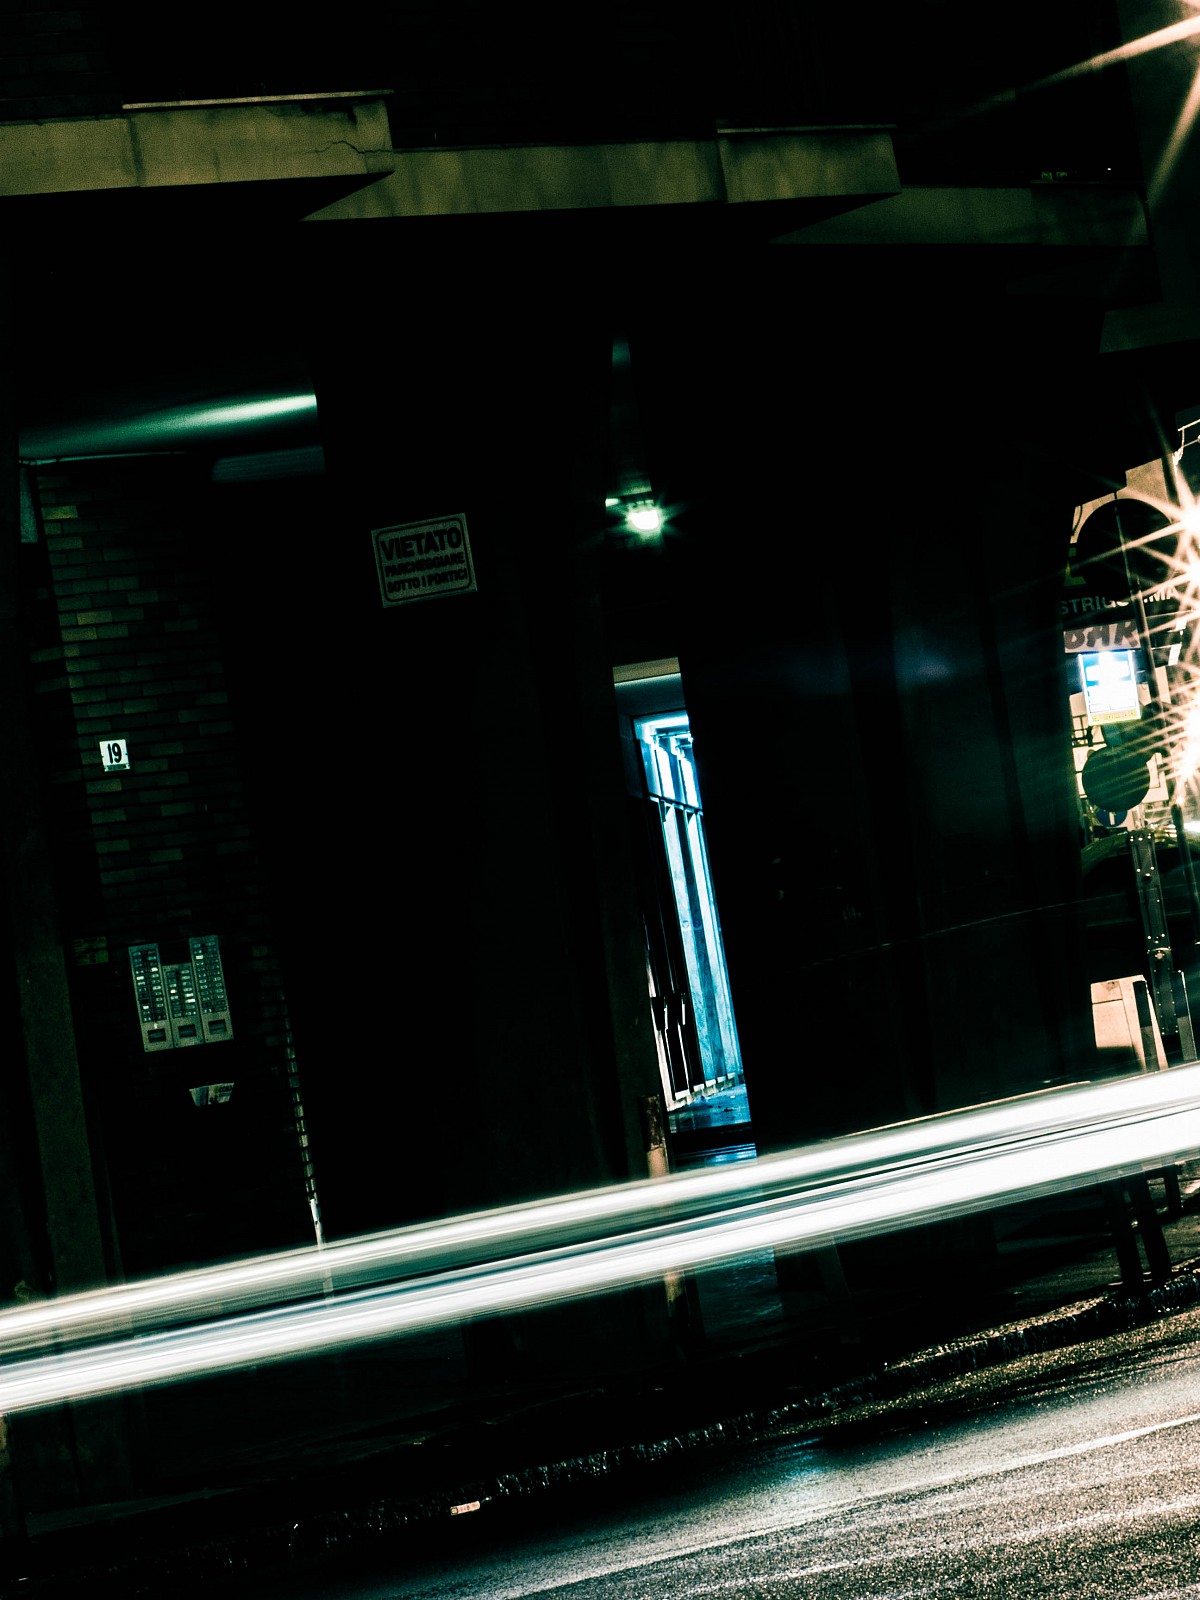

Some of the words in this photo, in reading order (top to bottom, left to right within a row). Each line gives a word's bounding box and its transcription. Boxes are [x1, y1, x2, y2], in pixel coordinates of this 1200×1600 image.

[380, 527, 462, 561] VIETATO
[385, 552, 465, 577] PARCHEGGIARE
[386, 577, 420, 593] SOTTO
[427, 568, 468, 586] PORTICI
[107, 742, 122, 764] 19
